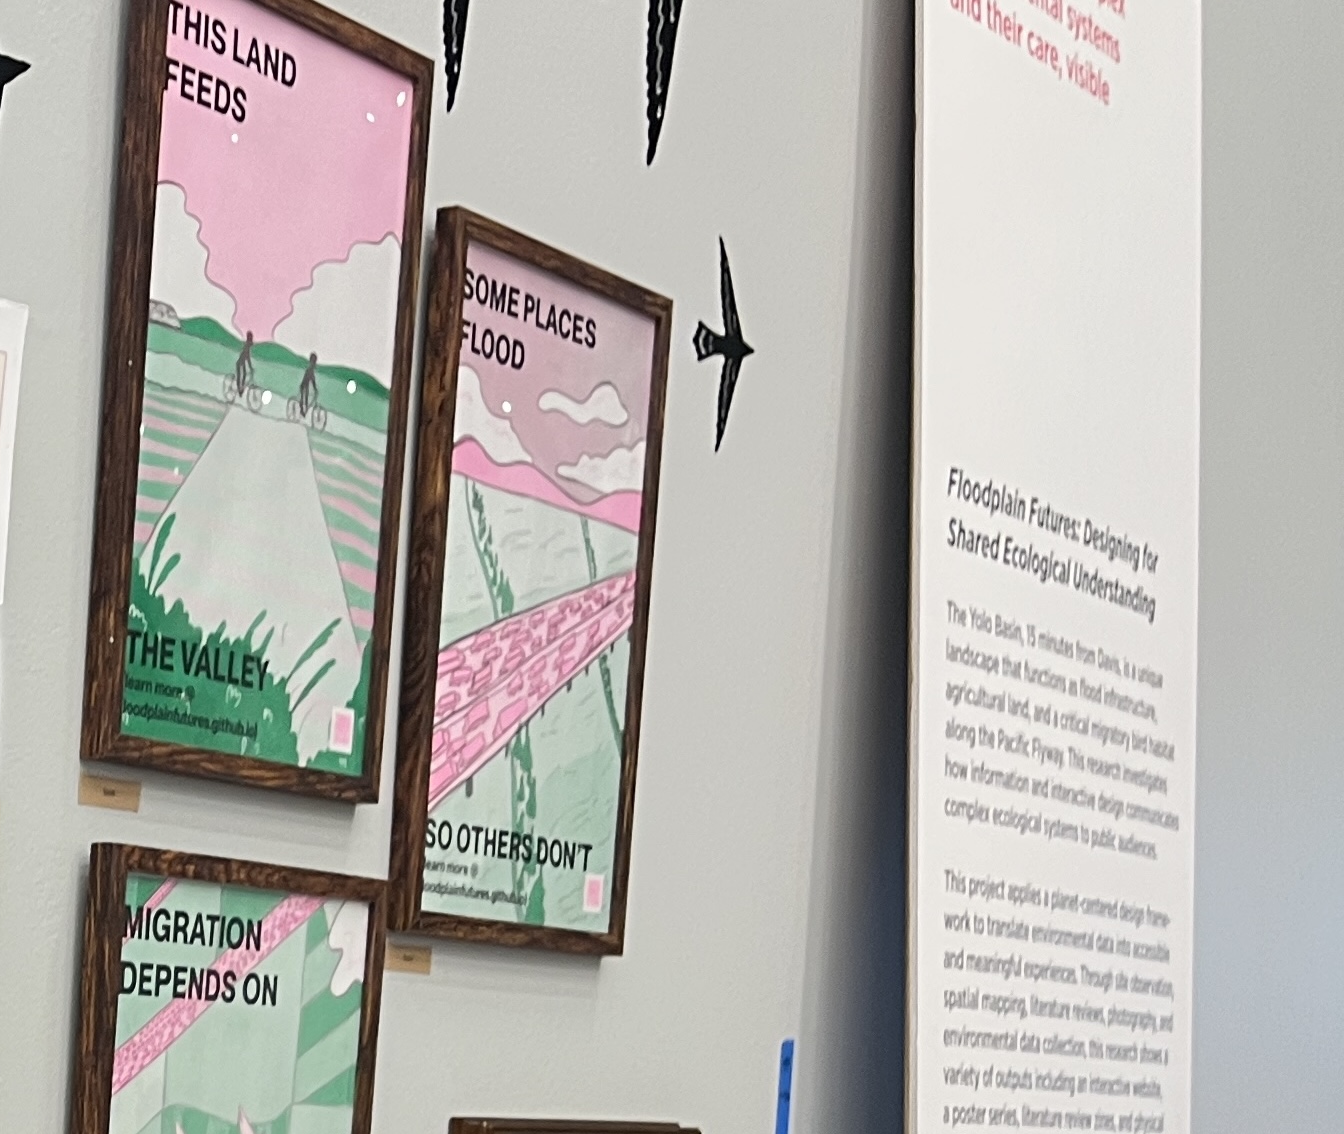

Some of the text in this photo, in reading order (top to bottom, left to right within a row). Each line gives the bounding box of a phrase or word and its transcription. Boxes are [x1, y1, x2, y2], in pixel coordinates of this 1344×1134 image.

[169, 1, 297, 87] THIS LAND
[1066, 4, 1121, 64] systems
[165, 60, 247, 123] FEEDS
[1027, 30, 1110, 106] care, visible
[462, 268, 596, 349] SOME PLACES
[459, 321, 525, 370] FLOOD
[947, 467, 1158, 573] Floodplain Futures: Designing for
[947, 518, 1156, 624] Shared Ecological Understanding
[947, 599, 966, 625] The
[127, 629, 270, 691] THE VALLEY
[425, 818, 593, 872] SO OTHERS DON'T
[124, 905, 262, 952] MIGRATION
[120, 961, 278, 1006] DEPENDS ON
